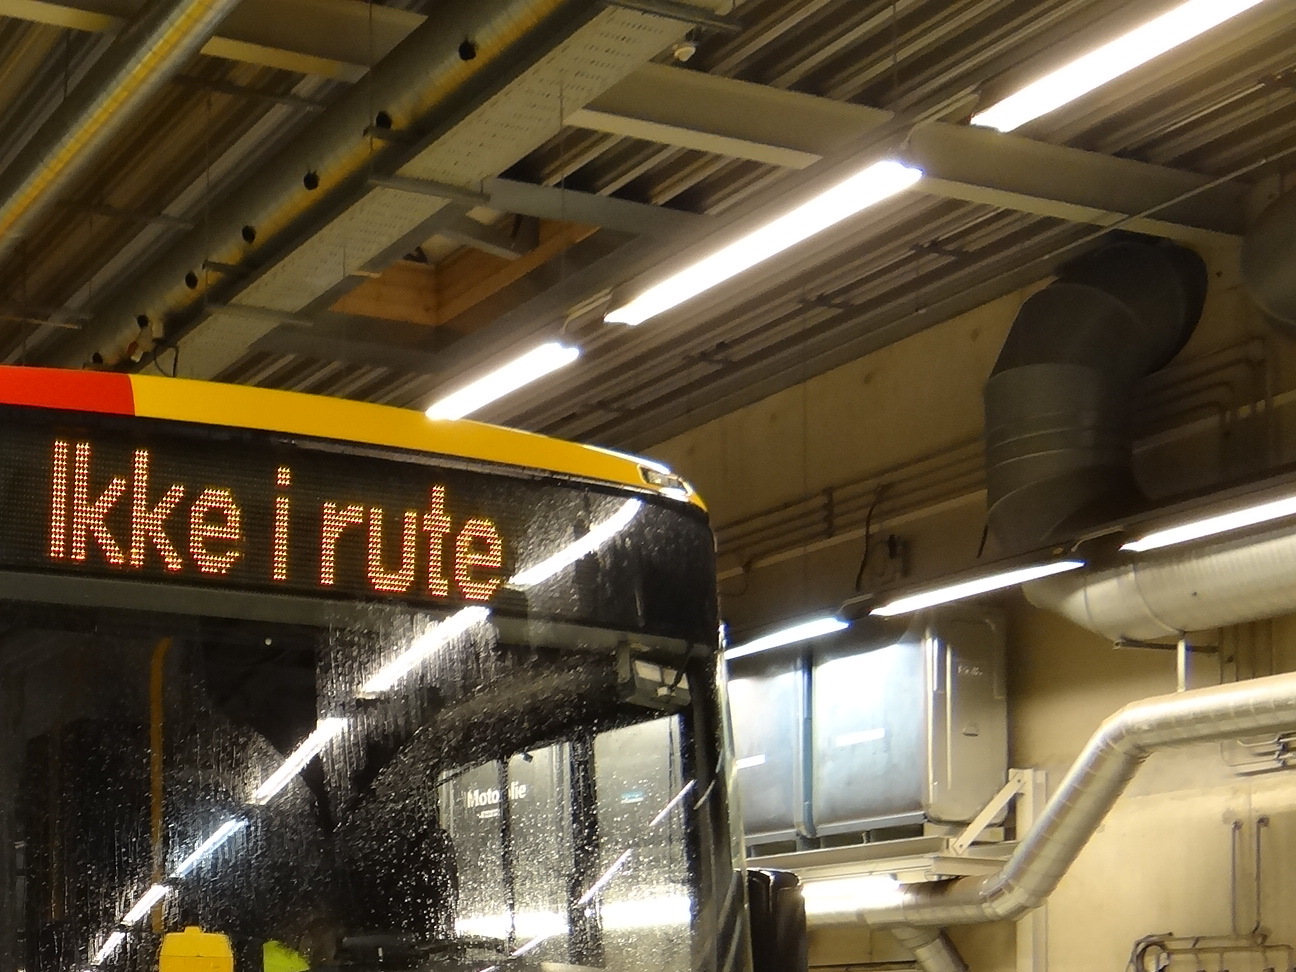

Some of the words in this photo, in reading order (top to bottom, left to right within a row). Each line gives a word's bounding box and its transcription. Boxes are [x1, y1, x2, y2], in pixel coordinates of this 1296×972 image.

[49, 440, 241, 574] Ikke
[272, 466, 292, 581] i
[319, 484, 503, 602] rute
[466, 780, 527, 808] Motolie
